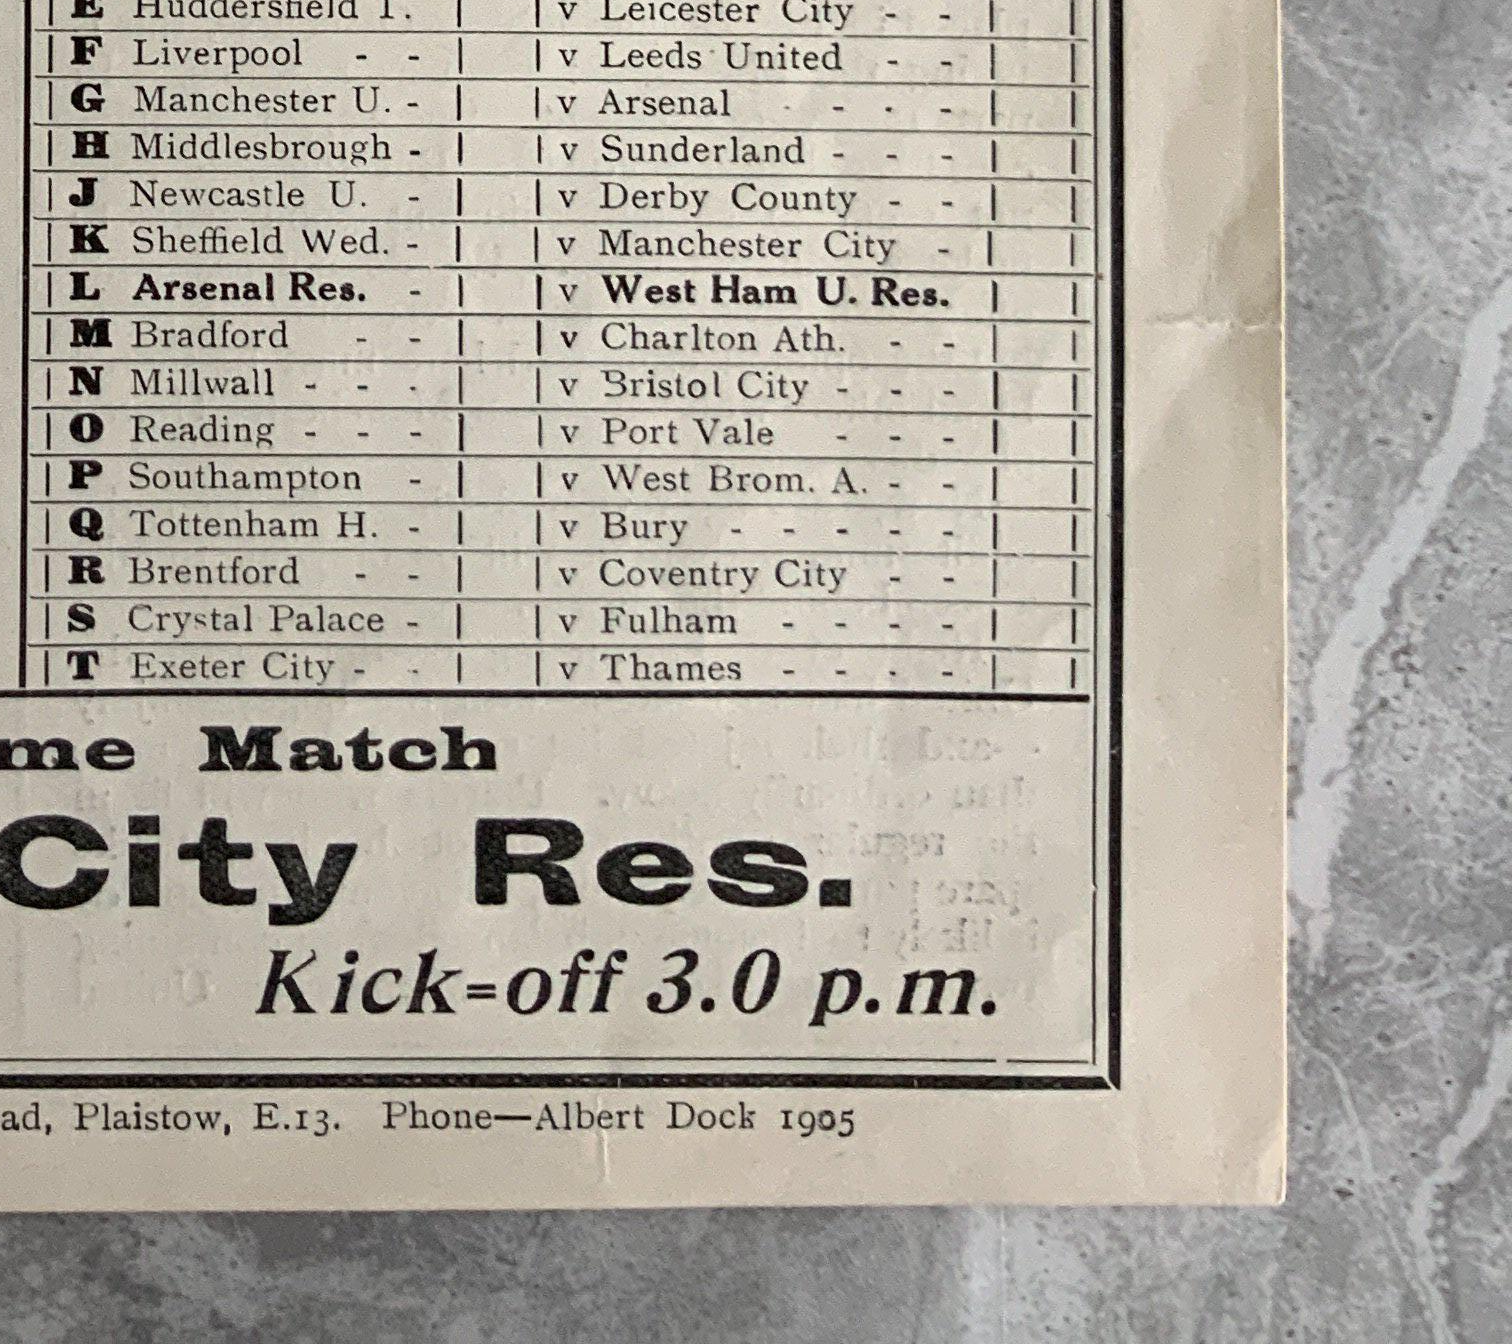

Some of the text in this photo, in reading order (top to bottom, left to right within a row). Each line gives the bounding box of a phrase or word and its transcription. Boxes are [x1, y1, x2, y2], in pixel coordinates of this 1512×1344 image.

[68, 271, 950, 307] L Arsenal Res. v West Ham U. Res.
[131, 651, 335, 681] Exeter City
[197, 725, 497, 773] Match
[474, 817, 852, 908] Res.
[646, 948, 781, 1015] 3.0
[807, 967, 997, 1028] p.m.
[73, 1101, 231, 1137] Plaistow,
[253, 1102, 340, 1137] E.13.
[666, 1101, 756, 1130] Dock
[780, 1109, 855, 1138] 1905
